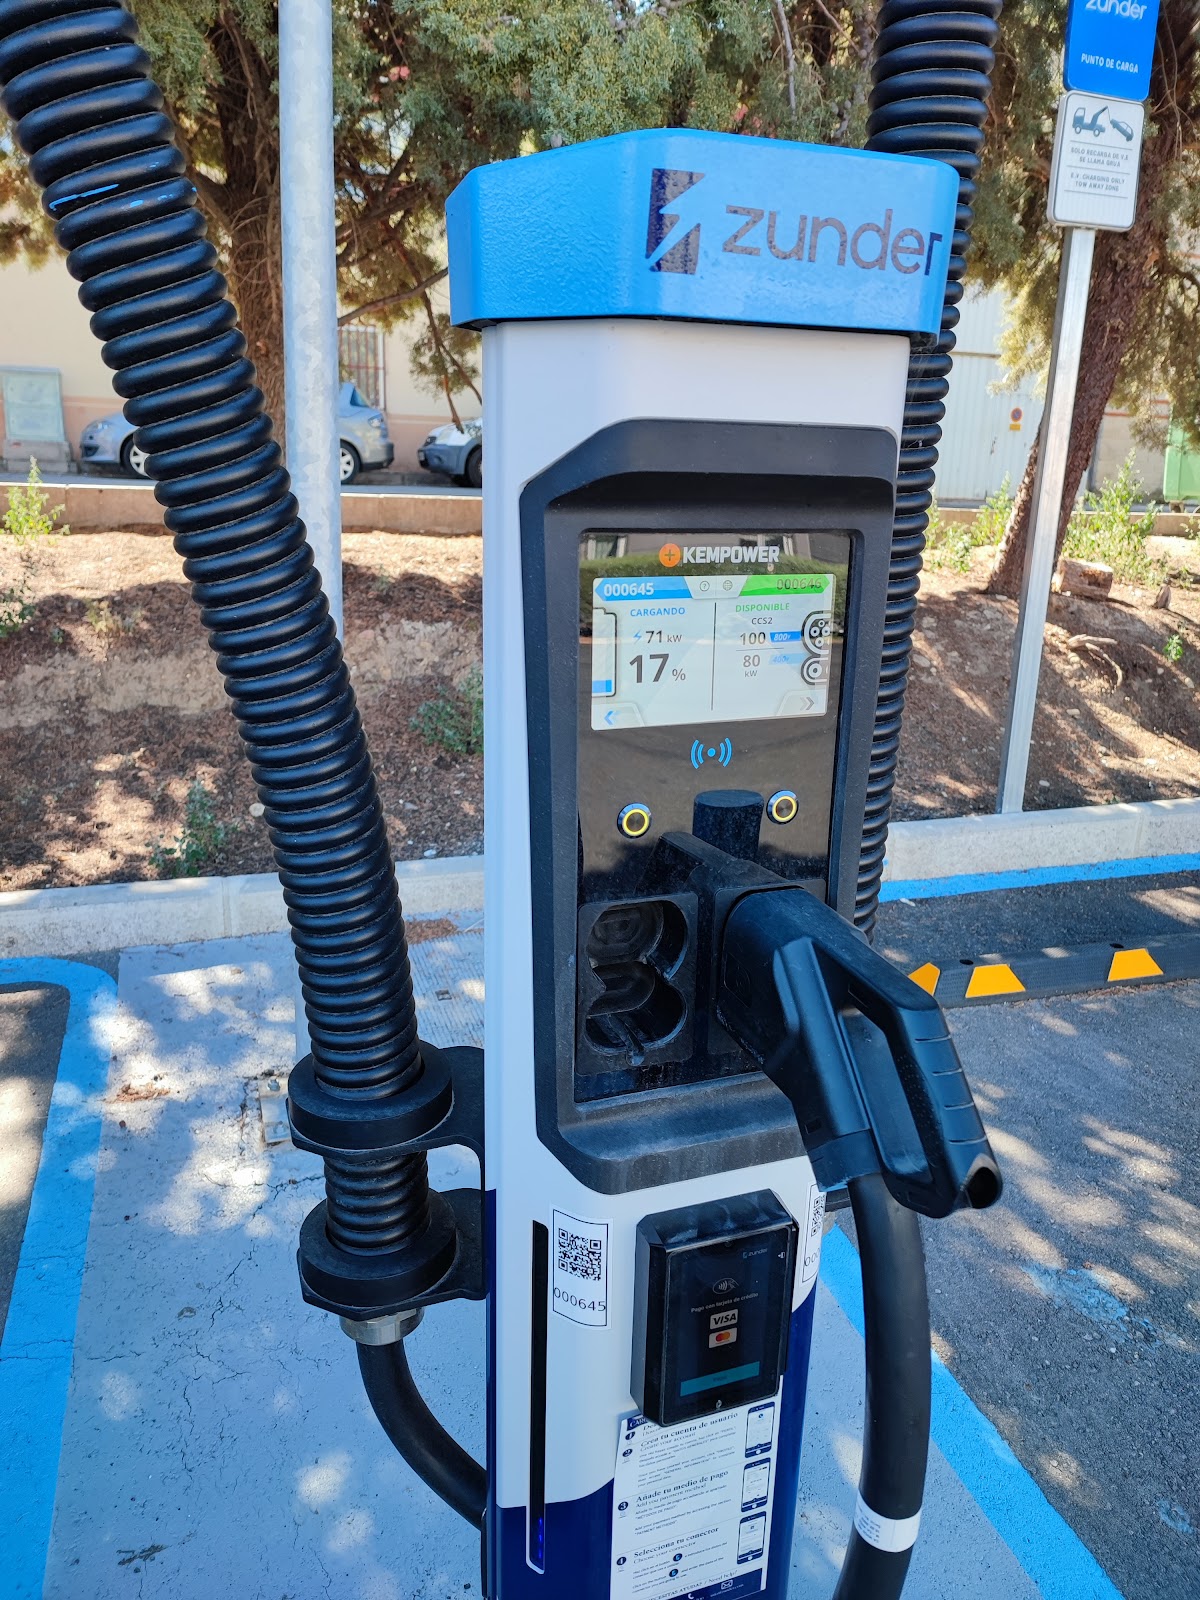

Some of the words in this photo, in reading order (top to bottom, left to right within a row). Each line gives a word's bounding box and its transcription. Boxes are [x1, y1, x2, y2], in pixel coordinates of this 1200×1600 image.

[1081, 53, 1104, 66] PUNTO
[1106, 58, 1114, 69] DE
[1116, 60, 1138, 73] CARGA
[722, 206, 944, 276] zunder
[682, 546, 780, 564] KEMPOWER
[604, 582, 654, 596] 000645
[776, 578, 822, 590] 000646
[630, 607, 686, 617] CARGANDO
[736, 603, 790, 612] DISPONIBLE
[751, 617, 773, 625] CCS2
[646, 630, 662, 644] 71
[667, 634, 682, 643] kW
[740, 632, 766, 645] 100
[743, 654, 760, 667] 80
[630, 653, 669, 683] 17
[672, 668, 686, 681] %
[554, 1287, 606, 1311] 000645
[713, 1313, 736, 1325] VISA
[641, 1437, 659, 1446] Crea
[671, 1426, 697, 1437] cuenta
[710, 1412, 738, 1424] usuario
[636, 1491, 661, 1502] Añade
[673, 1480, 698, 1491] medio
[710, 1471, 728, 1481] pago
[634, 1542, 675, 1558] Selecciona
[686, 1527, 719, 1541] conector
